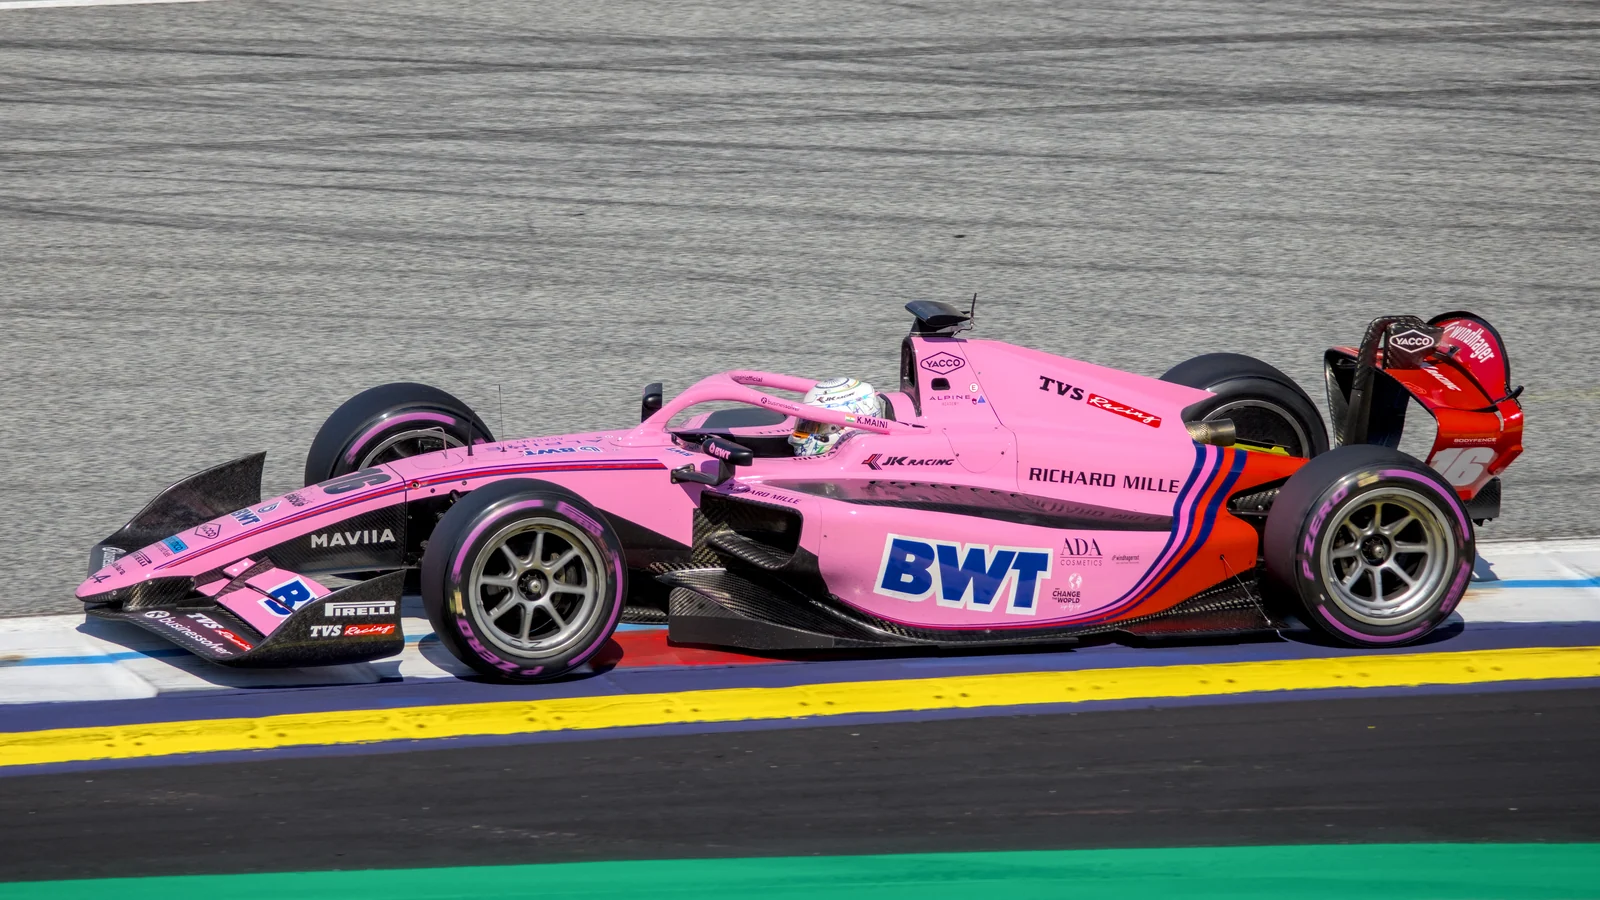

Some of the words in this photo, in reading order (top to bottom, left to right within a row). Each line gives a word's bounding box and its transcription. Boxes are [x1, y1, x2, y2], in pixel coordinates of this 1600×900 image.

[1395, 337, 1430, 346] YACCO
[1449, 323, 1495, 363] windhager
[926, 359, 960, 367] YACCO
[1039, 375, 1084, 401] TVS
[1088, 396, 1160, 424] Racing
[856, 416, 888, 429] K.MAINI
[714, 446, 731, 460] BWT
[882, 457, 904, 466] JK
[907, 458, 955, 467] RACING
[1430, 447, 1495, 486] 16
[1028, 467, 1116, 488] RICHARD
[1122, 474, 1180, 494] MILLE
[771, 494, 801, 505] MILLE
[311, 528, 396, 549] MAVIIA
[1060, 537, 1103, 556] ADA
[1060, 559, 1103, 567] COSMETICS
[877, 536, 1051, 613] BWT
[1052, 590, 1081, 598] CHANGE
[324, 600, 396, 617] PIRELLI
[186, 612, 224, 629] TVS
[159, 615, 234, 655] businessolver
[310, 625, 342, 638] TVS
[344, 624, 396, 638] Racing
